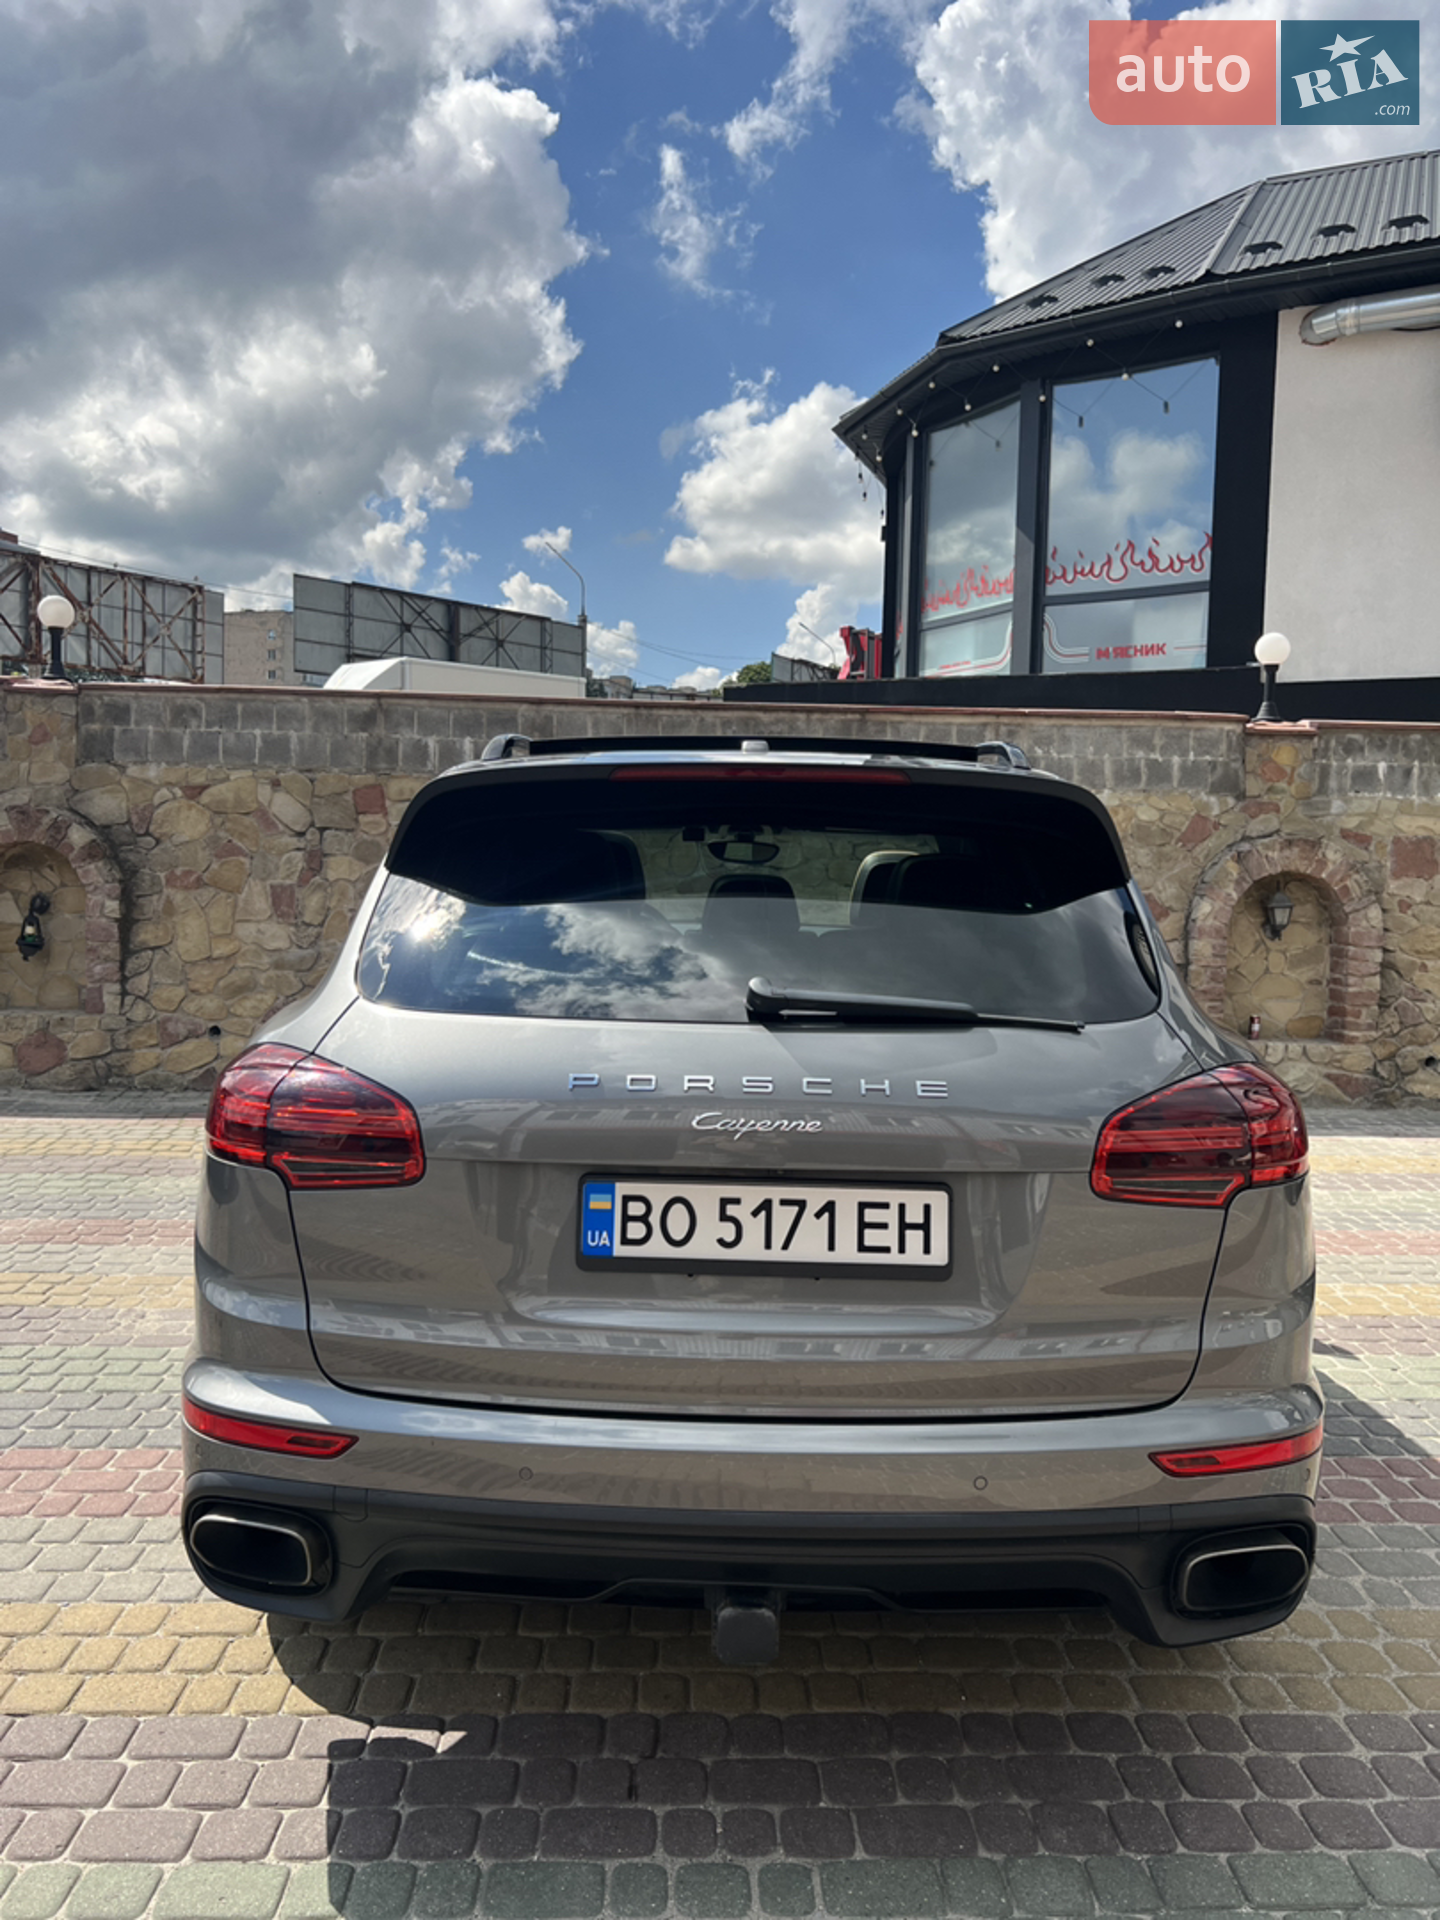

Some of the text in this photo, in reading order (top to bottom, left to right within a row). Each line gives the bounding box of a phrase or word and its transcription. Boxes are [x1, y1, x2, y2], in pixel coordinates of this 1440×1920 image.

[568, 1073, 948, 1097] PORSCHE
[691, 1112, 823, 1140] Cayenne
[619, 1194, 932, 1256] BO 5171 EH
[587, 1230, 611, 1248] UA
